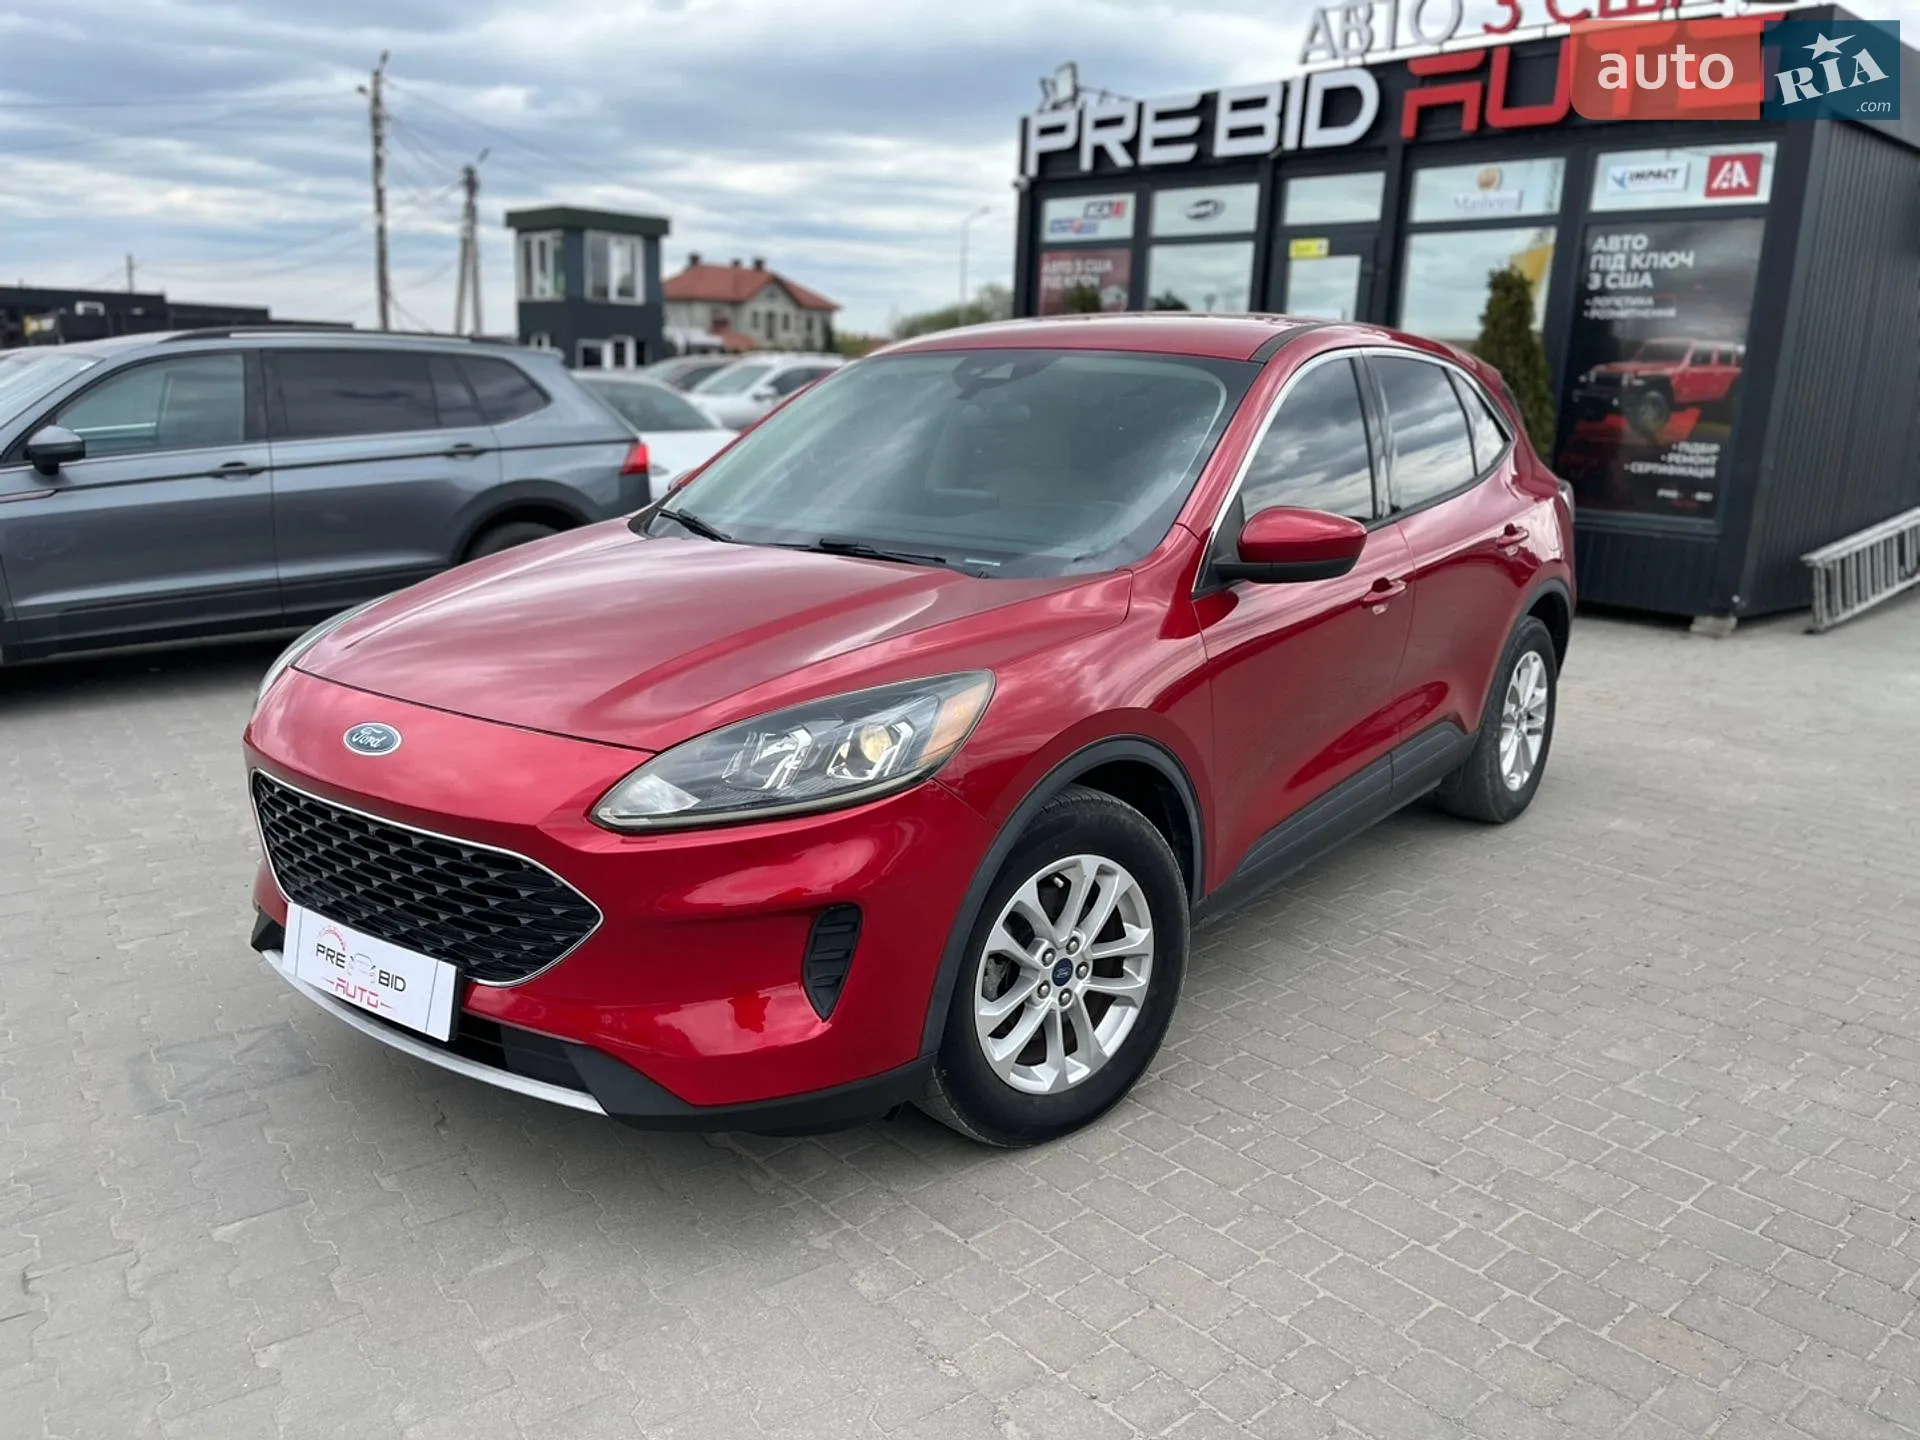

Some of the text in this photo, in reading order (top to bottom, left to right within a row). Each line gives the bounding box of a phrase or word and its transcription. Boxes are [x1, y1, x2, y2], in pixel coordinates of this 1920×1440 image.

[1026, 93, 1202, 177] PRE
[1211, 66, 1380, 158] BID
[1591, 233, 1649, 253] АВТО
[1630, 250, 1695, 270] КЛЮЧ
[1604, 271, 1654, 291] США
[351, 726, 388, 749] Ford
[315, 942, 407, 993] PRE BID
[334, 976, 380, 1009] AUTO
